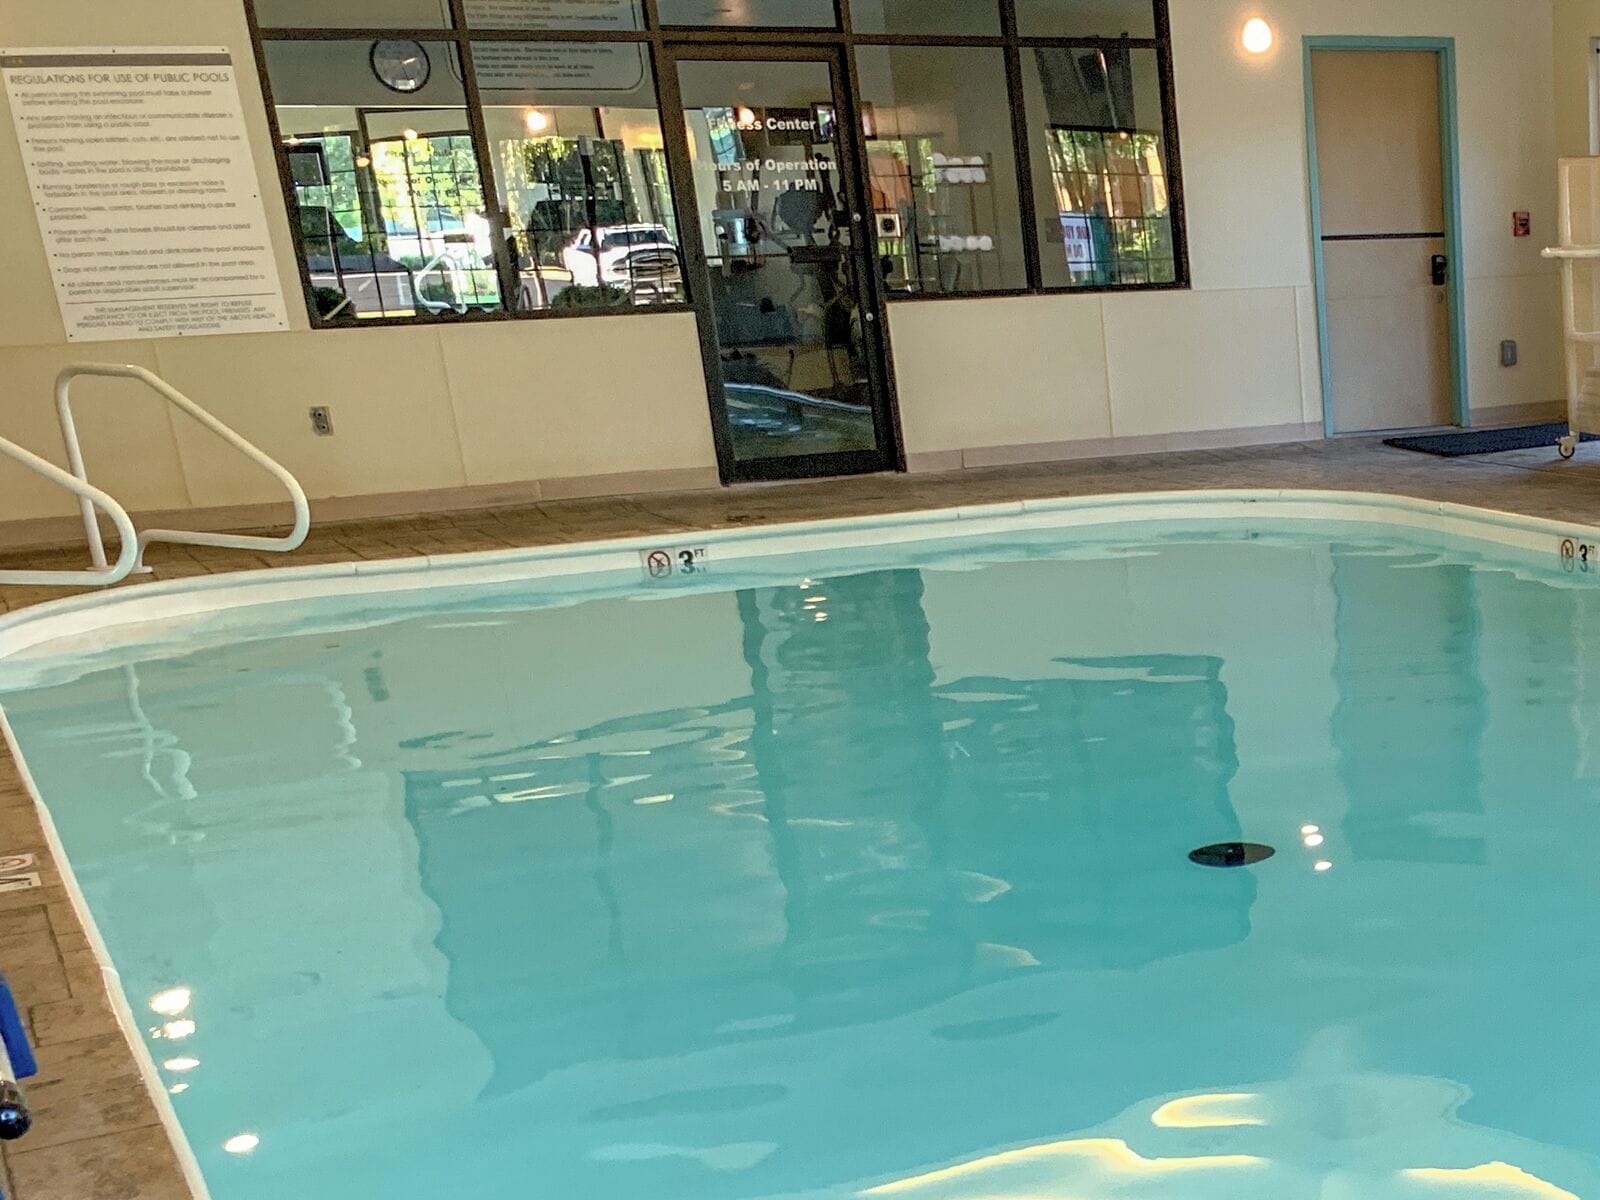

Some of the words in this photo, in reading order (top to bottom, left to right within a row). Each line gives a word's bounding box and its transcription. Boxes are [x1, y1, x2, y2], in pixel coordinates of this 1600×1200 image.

[10, 74, 85, 84] REGULATIONS
[88, 74, 110, 83] FOR
[113, 74, 132, 82] USE
[136, 74, 148, 82] OF
[154, 73, 190, 82] PUBLIC
[193, 72, 229, 82] POOLS
[766, 118, 816, 130] Center
[746, 158, 760, 171] of
[765, 158, 837, 173] Operation
[723, 181, 732, 192] 5
[736, 180, 759, 191] AM
[775, 180, 787, 191] 11
[795, 179, 817, 191] PM
[679, 550, 695, 574] 3
[694, 548, 704, 558] FT
